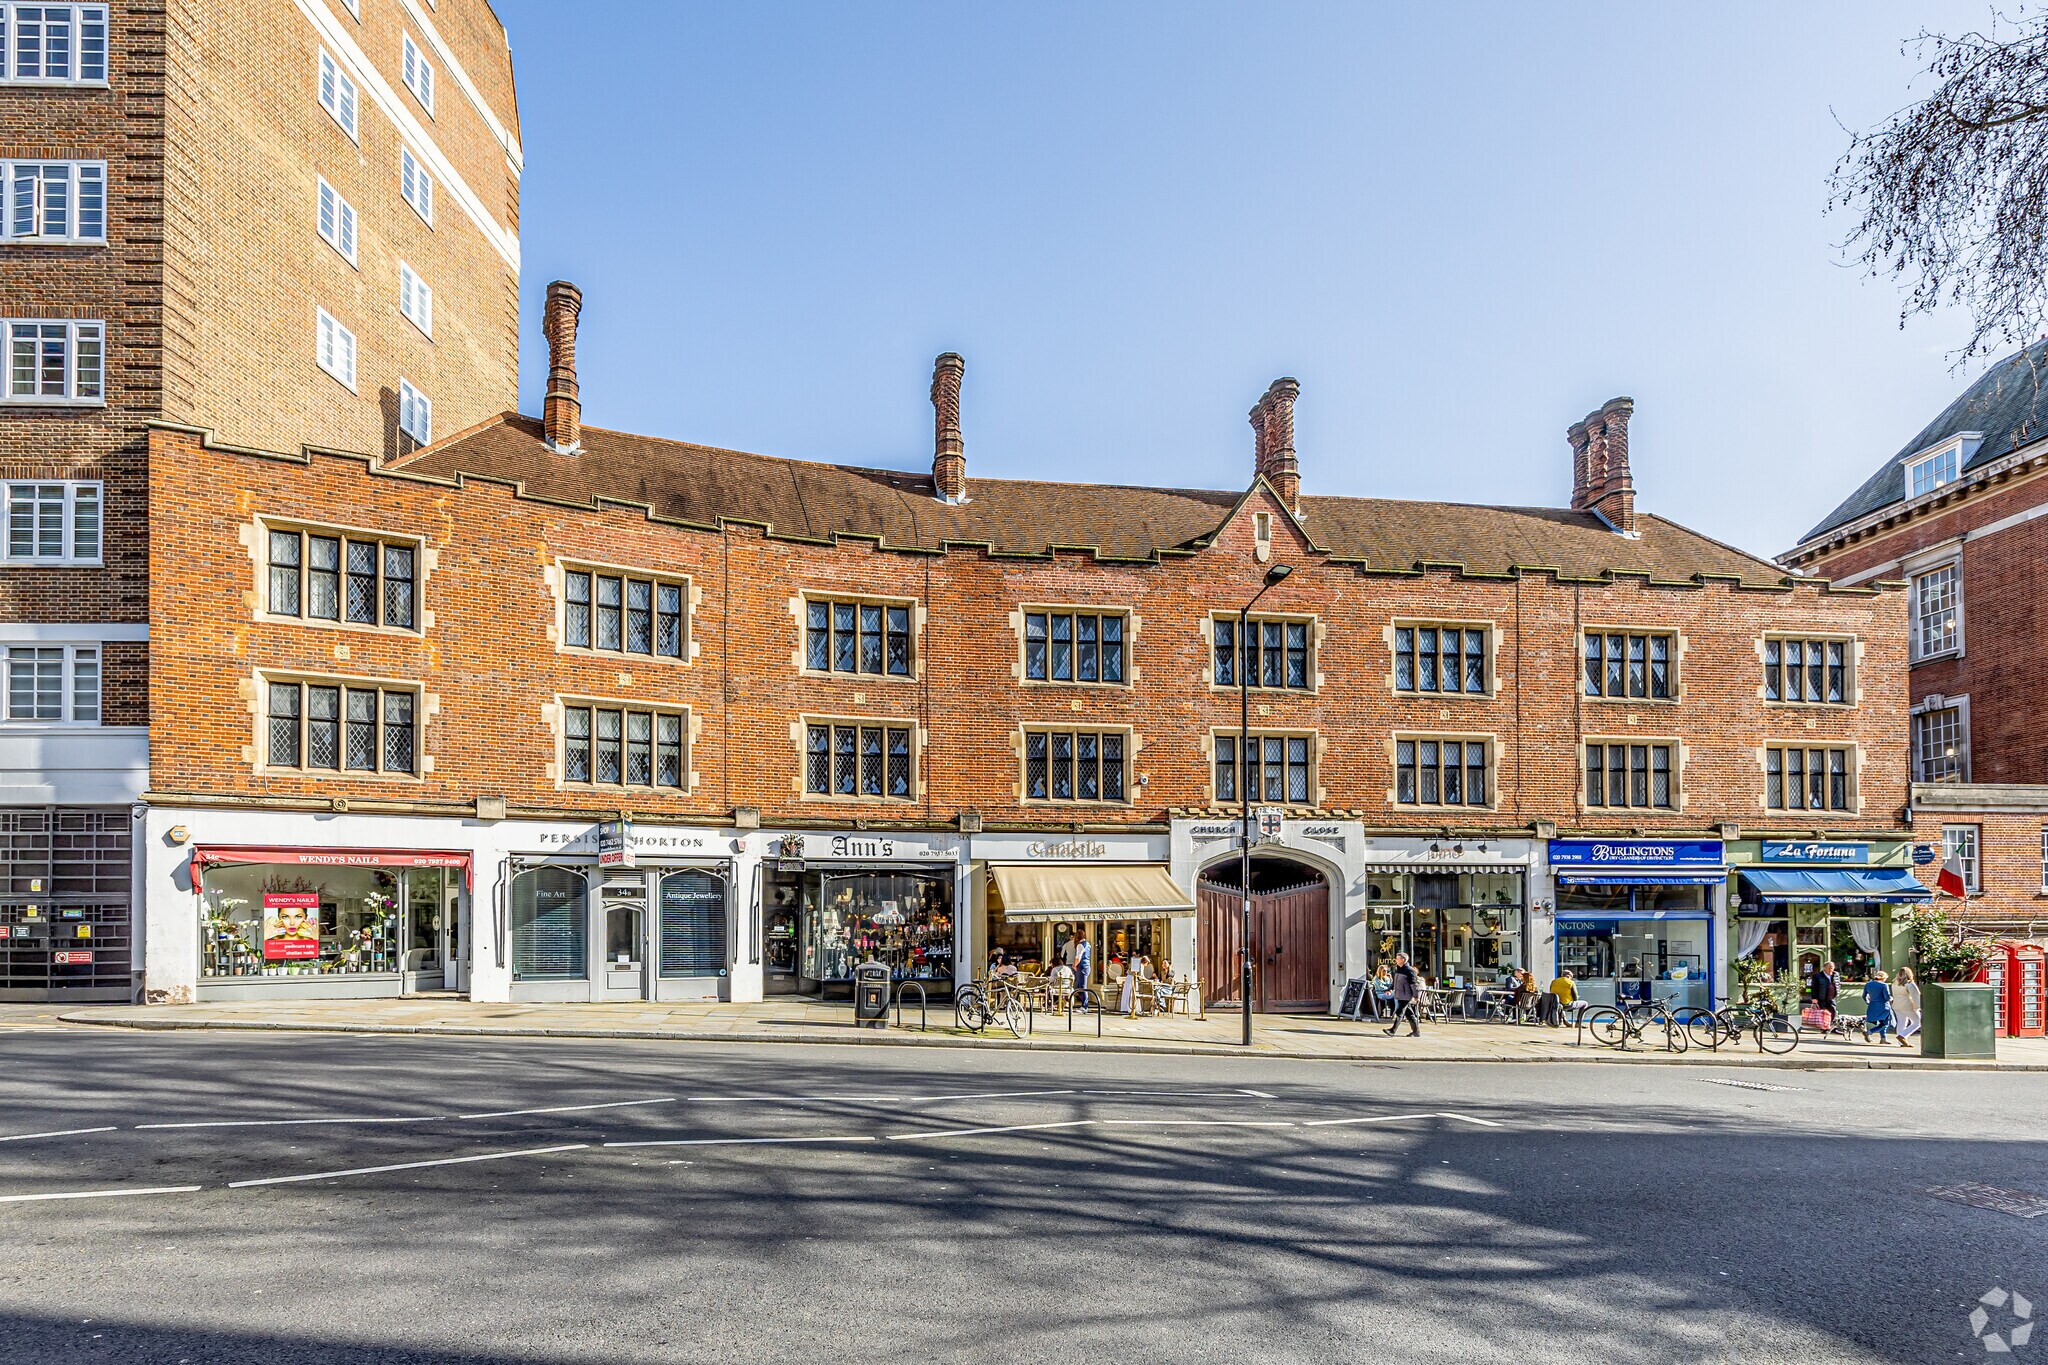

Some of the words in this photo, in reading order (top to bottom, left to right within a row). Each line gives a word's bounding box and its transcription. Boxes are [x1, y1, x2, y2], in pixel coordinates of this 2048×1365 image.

[1192, 826, 1236, 834] CHURCH
[1304, 826, 1340, 835] CLOSE
[539, 833, 598, 844] PERSIS
[633, 836, 704, 848] HORTON
[831, 833, 893, 857] Ann's
[1592, 844, 1674, 861] BURLINGTONS
[1779, 844, 1801, 856] La
[1805, 844, 1856, 858] Fortuna
[299, 855, 345, 864] WENDY'S
[347, 856, 379, 865] NAILS
[536, 890, 551, 898] Fine
[666, 892, 692, 900] Antique
[693, 892, 722, 901] Jewellery
